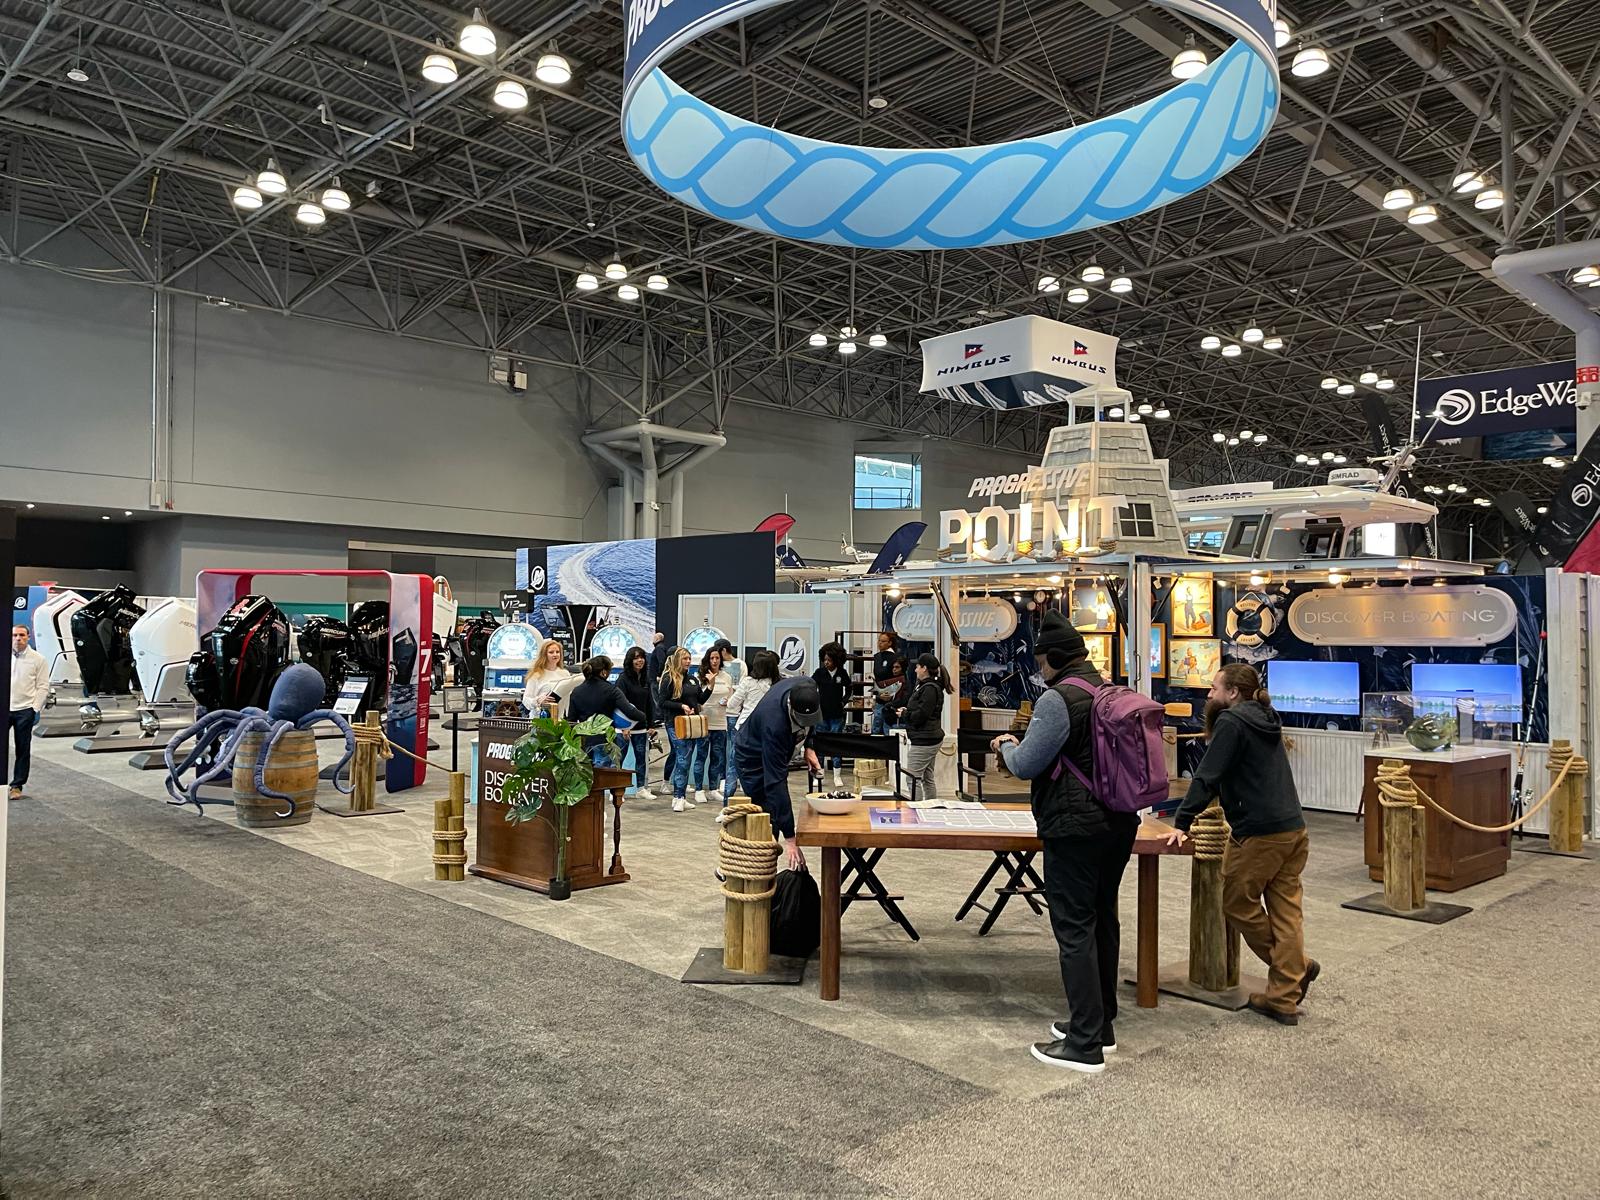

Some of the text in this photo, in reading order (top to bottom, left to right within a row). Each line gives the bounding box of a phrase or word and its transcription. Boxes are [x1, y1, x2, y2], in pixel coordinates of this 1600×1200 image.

[937, 354, 1012, 376] NIMBUS
[1051, 355, 1107, 374] NIMBUS
[968, 466, 1091, 498] PROGRESSIVE
[1331, 471, 1360, 480] SIMRAD
[939, 494, 1130, 563] POINT
[905, 611, 996, 629] PROSSIVE
[1304, 608, 1496, 624] DISCOVER BOATNG
[421, 648, 432, 674] 7
[485, 770, 549, 794] DISCER
